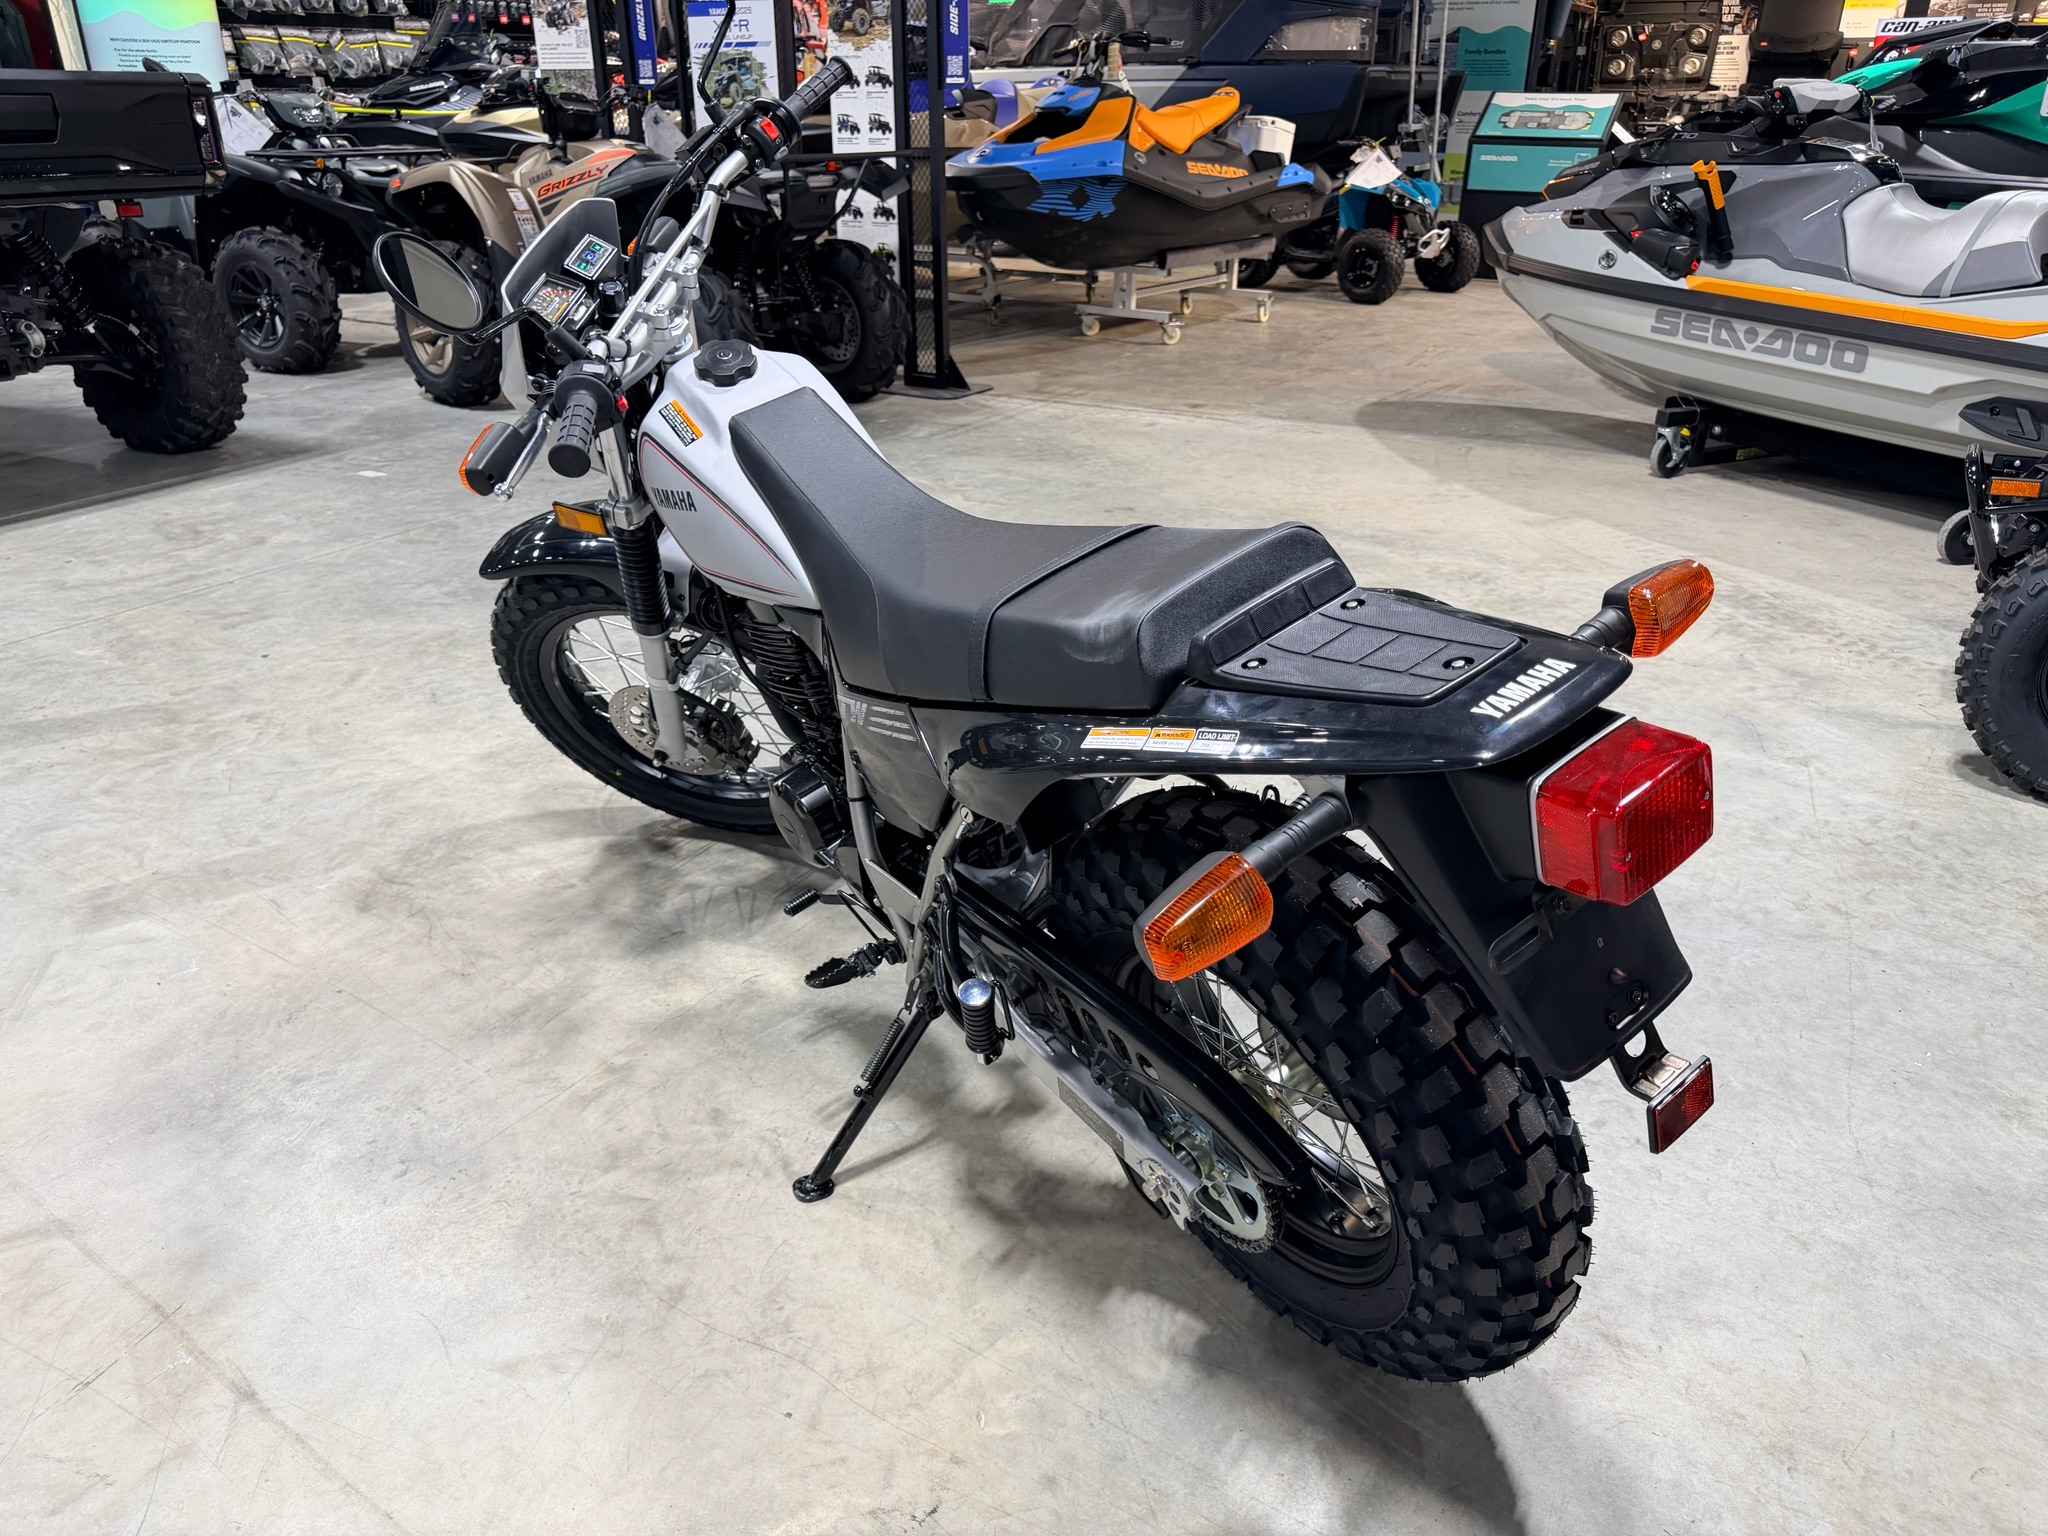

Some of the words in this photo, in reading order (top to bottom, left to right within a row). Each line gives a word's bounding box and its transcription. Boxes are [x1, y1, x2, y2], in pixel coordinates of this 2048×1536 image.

[1671, 131, 1700, 139] 170
[536, 163, 610, 200] GRIZZLY
[650, 486, 698, 513] YAMAHA
[1469, 658, 1577, 719] YAMAHA
[1198, 732, 1217, 740] LOAD
